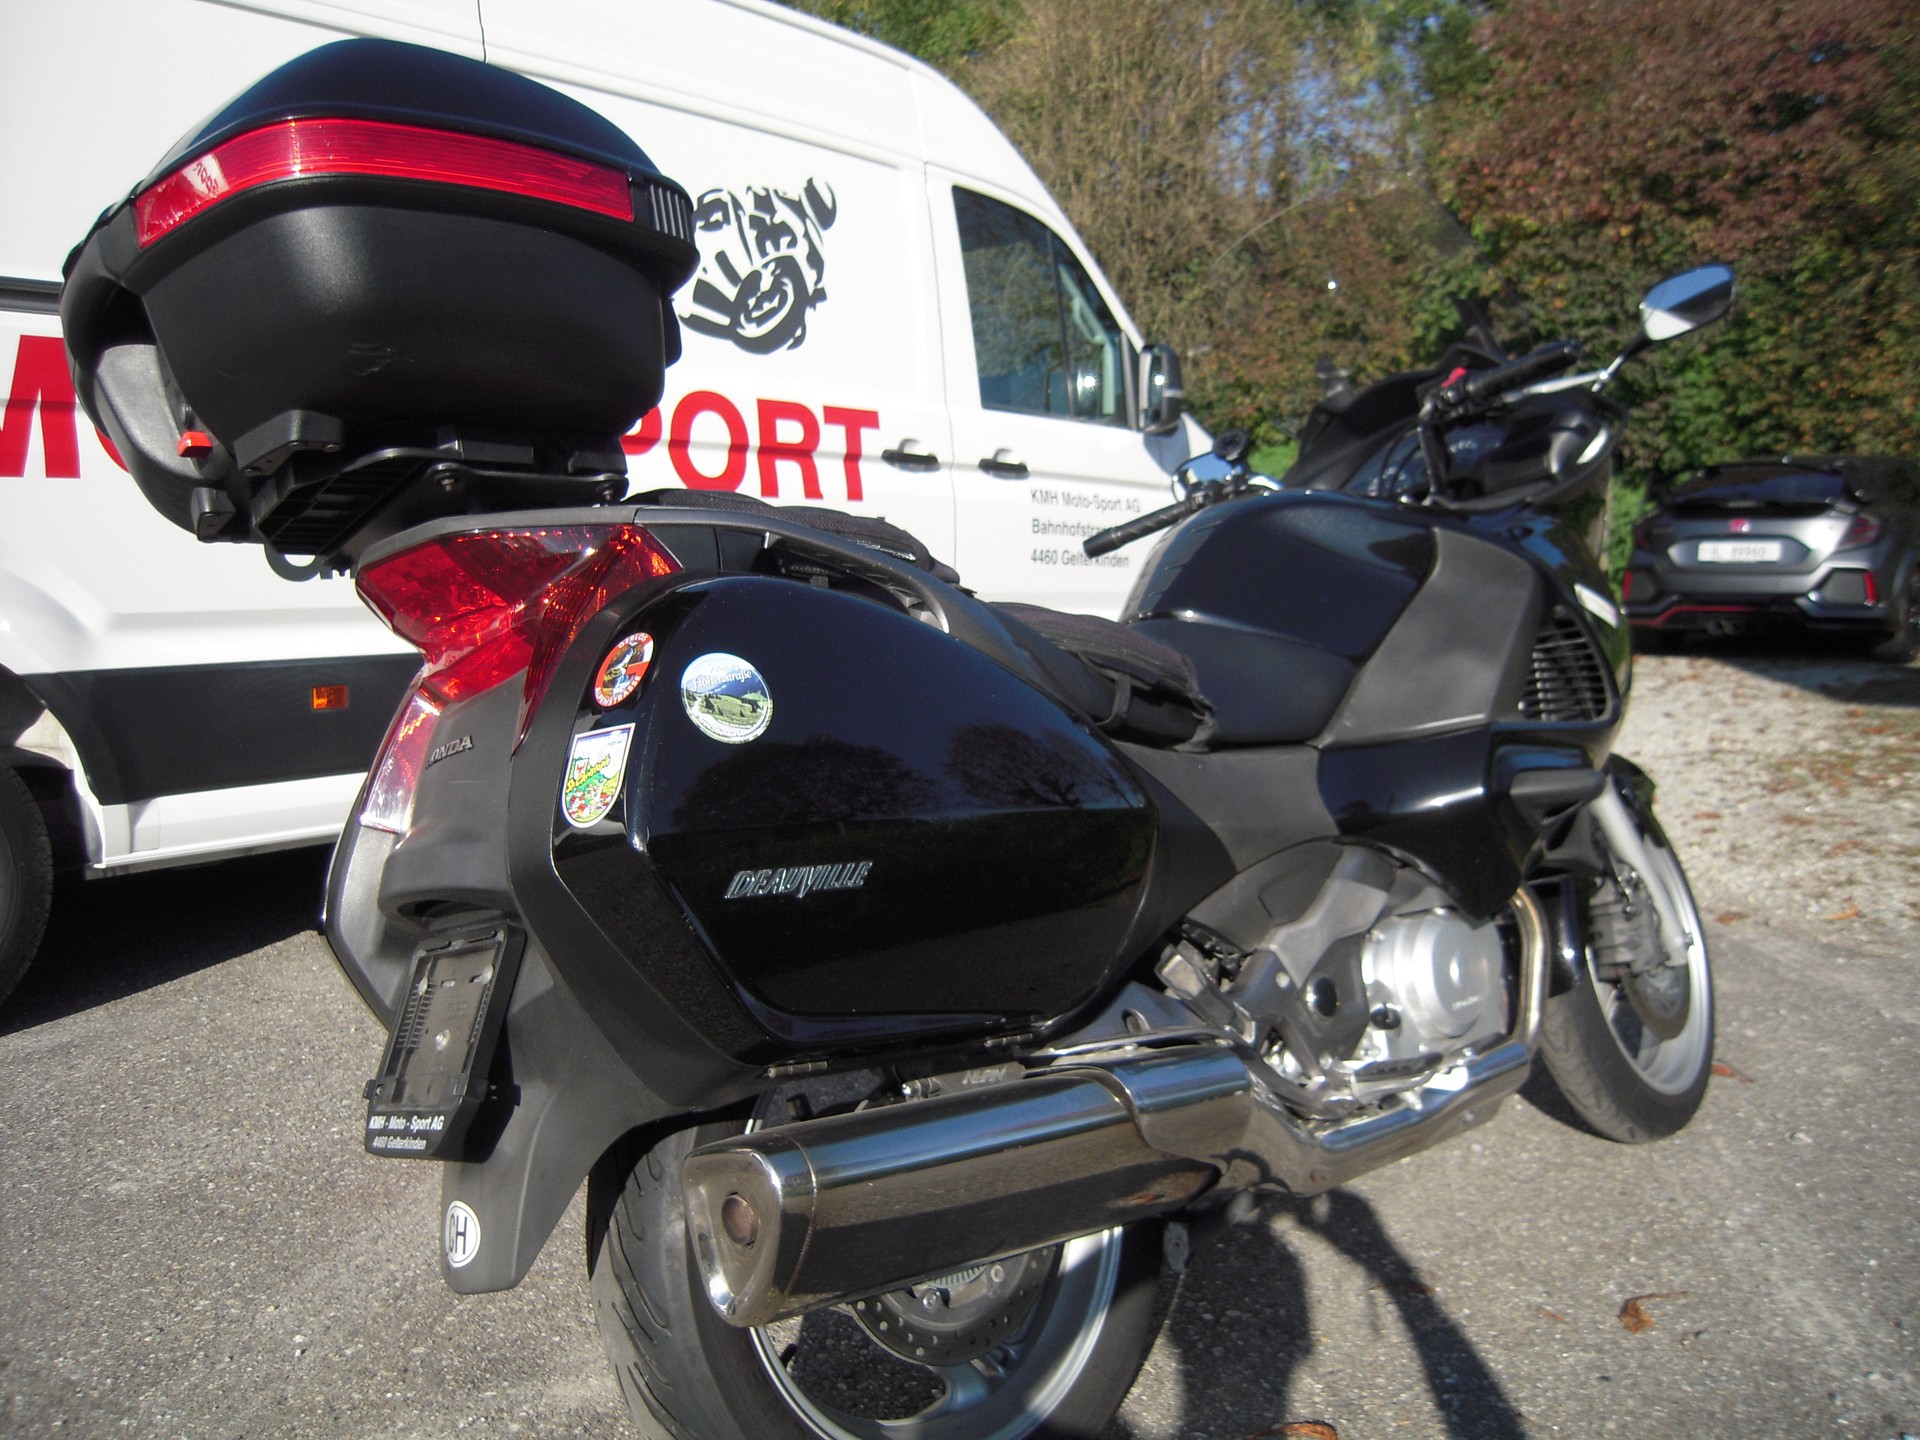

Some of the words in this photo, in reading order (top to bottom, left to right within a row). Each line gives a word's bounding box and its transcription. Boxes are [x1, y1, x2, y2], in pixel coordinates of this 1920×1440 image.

[1030, 488, 1058, 505] KMH
[1062, 492, 1122, 515] Moto-Sport
[1125, 498, 1141, 513] AG
[1031, 549, 1058, 565] 4460
[427, 735, 474, 768] ONDA
[724, 861, 873, 899] DEAUVILLE
[368, 1115, 386, 1129] KMH
[388, 1115, 406, 1129] Moto
[410, 1115, 432, 1133] Sport
[430, 1115, 445, 1130] AG
[449, 1213, 467, 1255] CH
